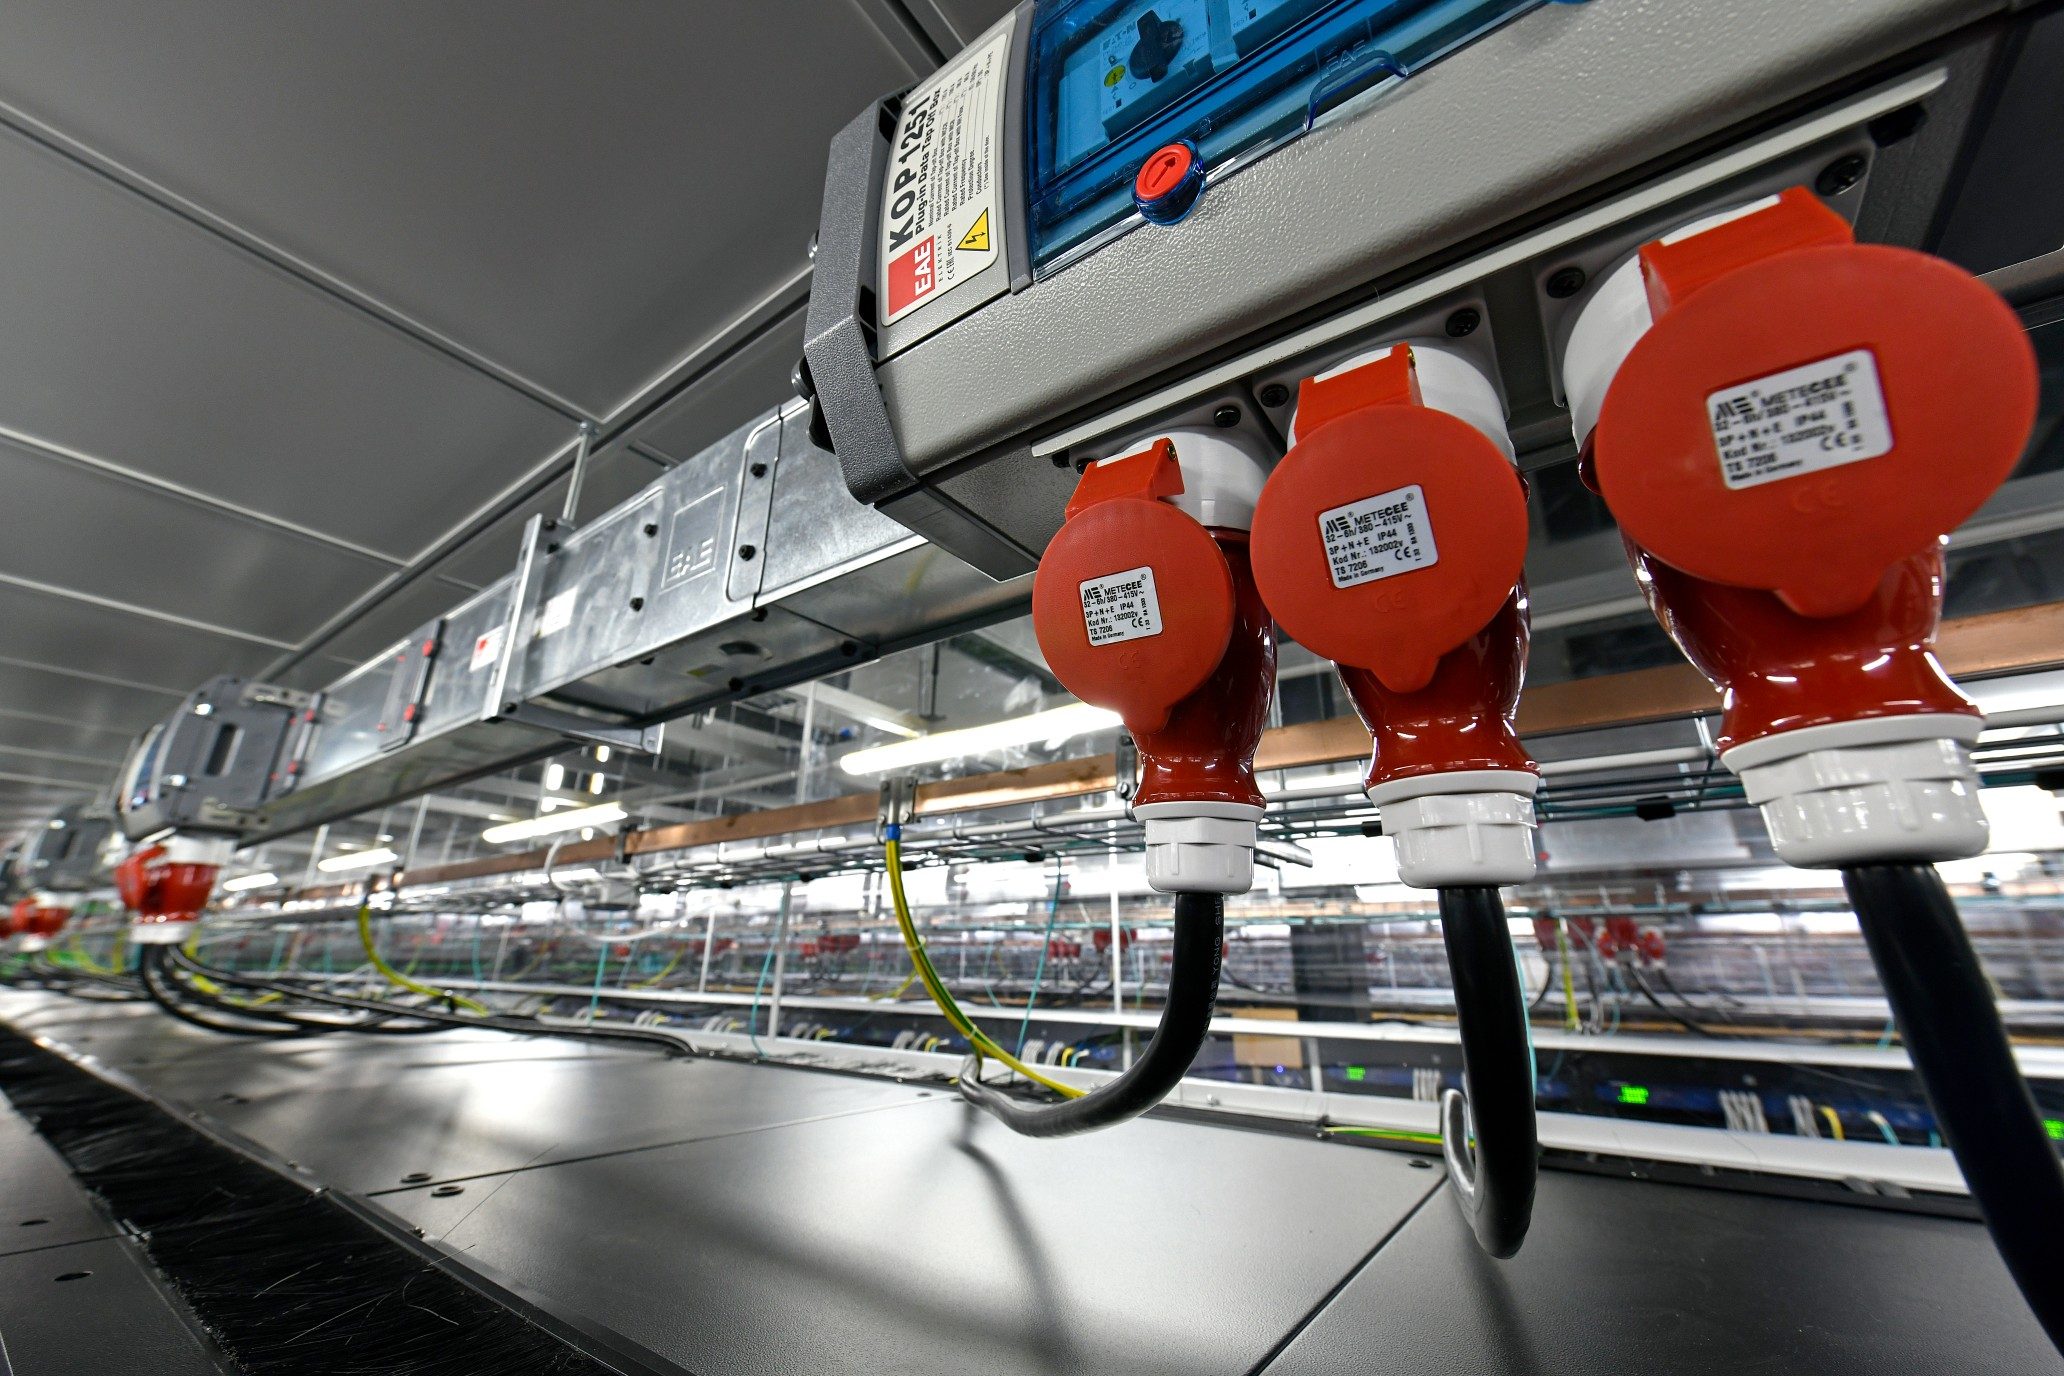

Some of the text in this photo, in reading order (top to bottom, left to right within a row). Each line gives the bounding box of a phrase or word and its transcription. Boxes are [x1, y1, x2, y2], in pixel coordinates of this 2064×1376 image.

[915, 87, 941, 235] Plug-in Data Tap Off Box
[889, 96, 931, 253] KOP 1251
[959, 158, 967, 188] Frequency
[915, 241, 932, 296] EAE
[1377, 529, 1397, 541] IP44
[1332, 554, 1348, 565] Kod
[1369, 540, 1403, 555] 132002v
[1335, 560, 1368, 575] TS 7206
[1360, 566, 1384, 576] Germany
[1120, 601, 1134, 610] IP44
[1088, 618, 1099, 627] Kod
[1114, 611, 1138, 621] 132002v
[1099, 625, 1113, 634] 7206
